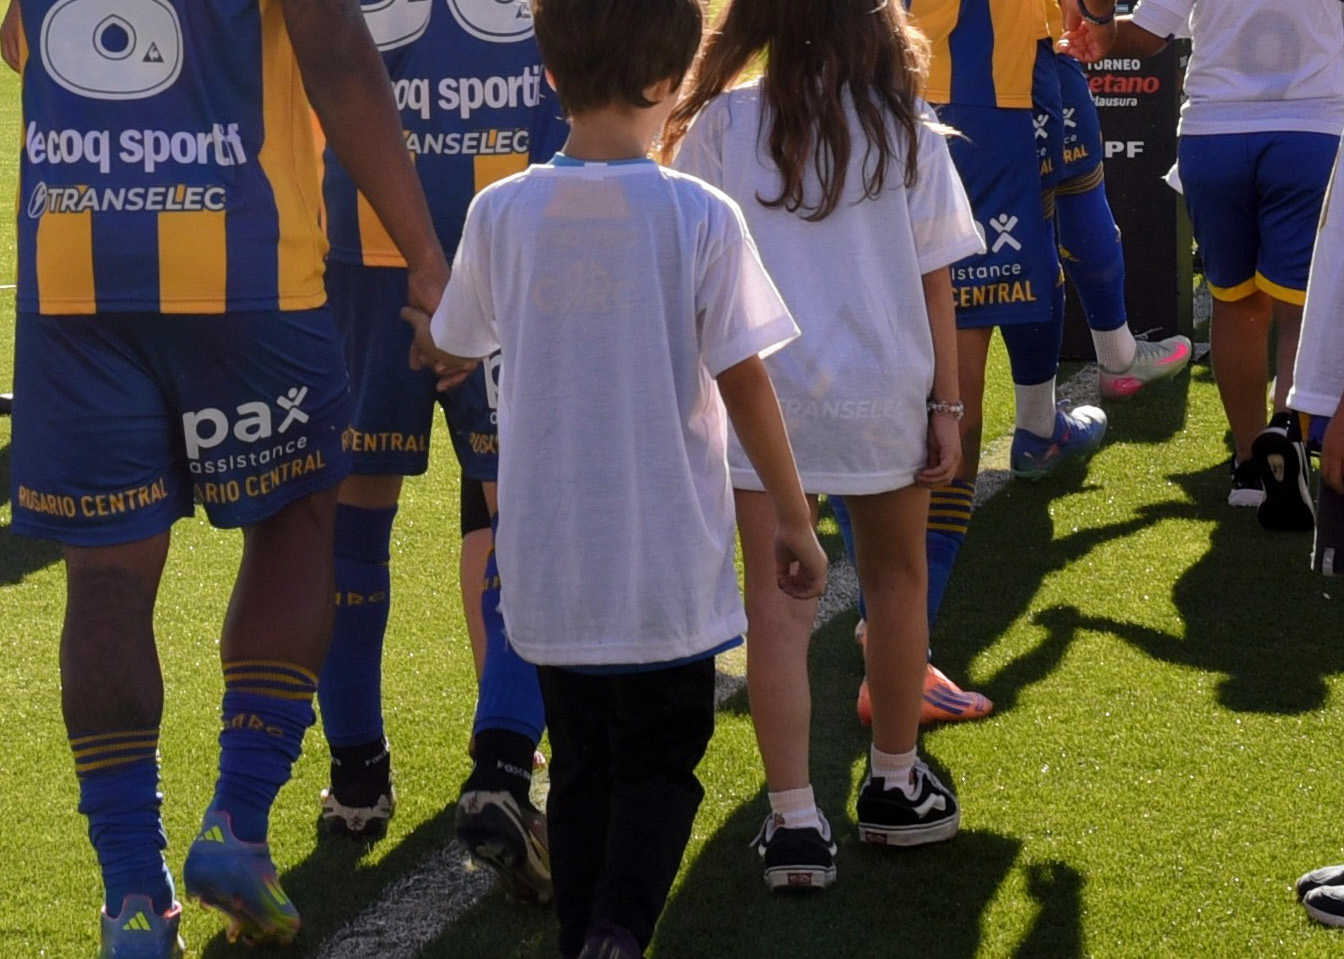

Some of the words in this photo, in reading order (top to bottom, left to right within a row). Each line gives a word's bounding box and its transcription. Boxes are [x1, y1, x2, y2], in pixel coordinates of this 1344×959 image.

[1088, 74, 1160, 93] etano
[1093, 96, 1138, 107] lausura
[1105, 141, 1144, 158] PF
[48, 187, 226, 211] TRANSELEC
[183, 386, 309, 459] pax
[190, 436, 307, 474] assistance
[246, 450, 326, 497] CENTRAL
[80, 478, 168, 516] CENTRAL
